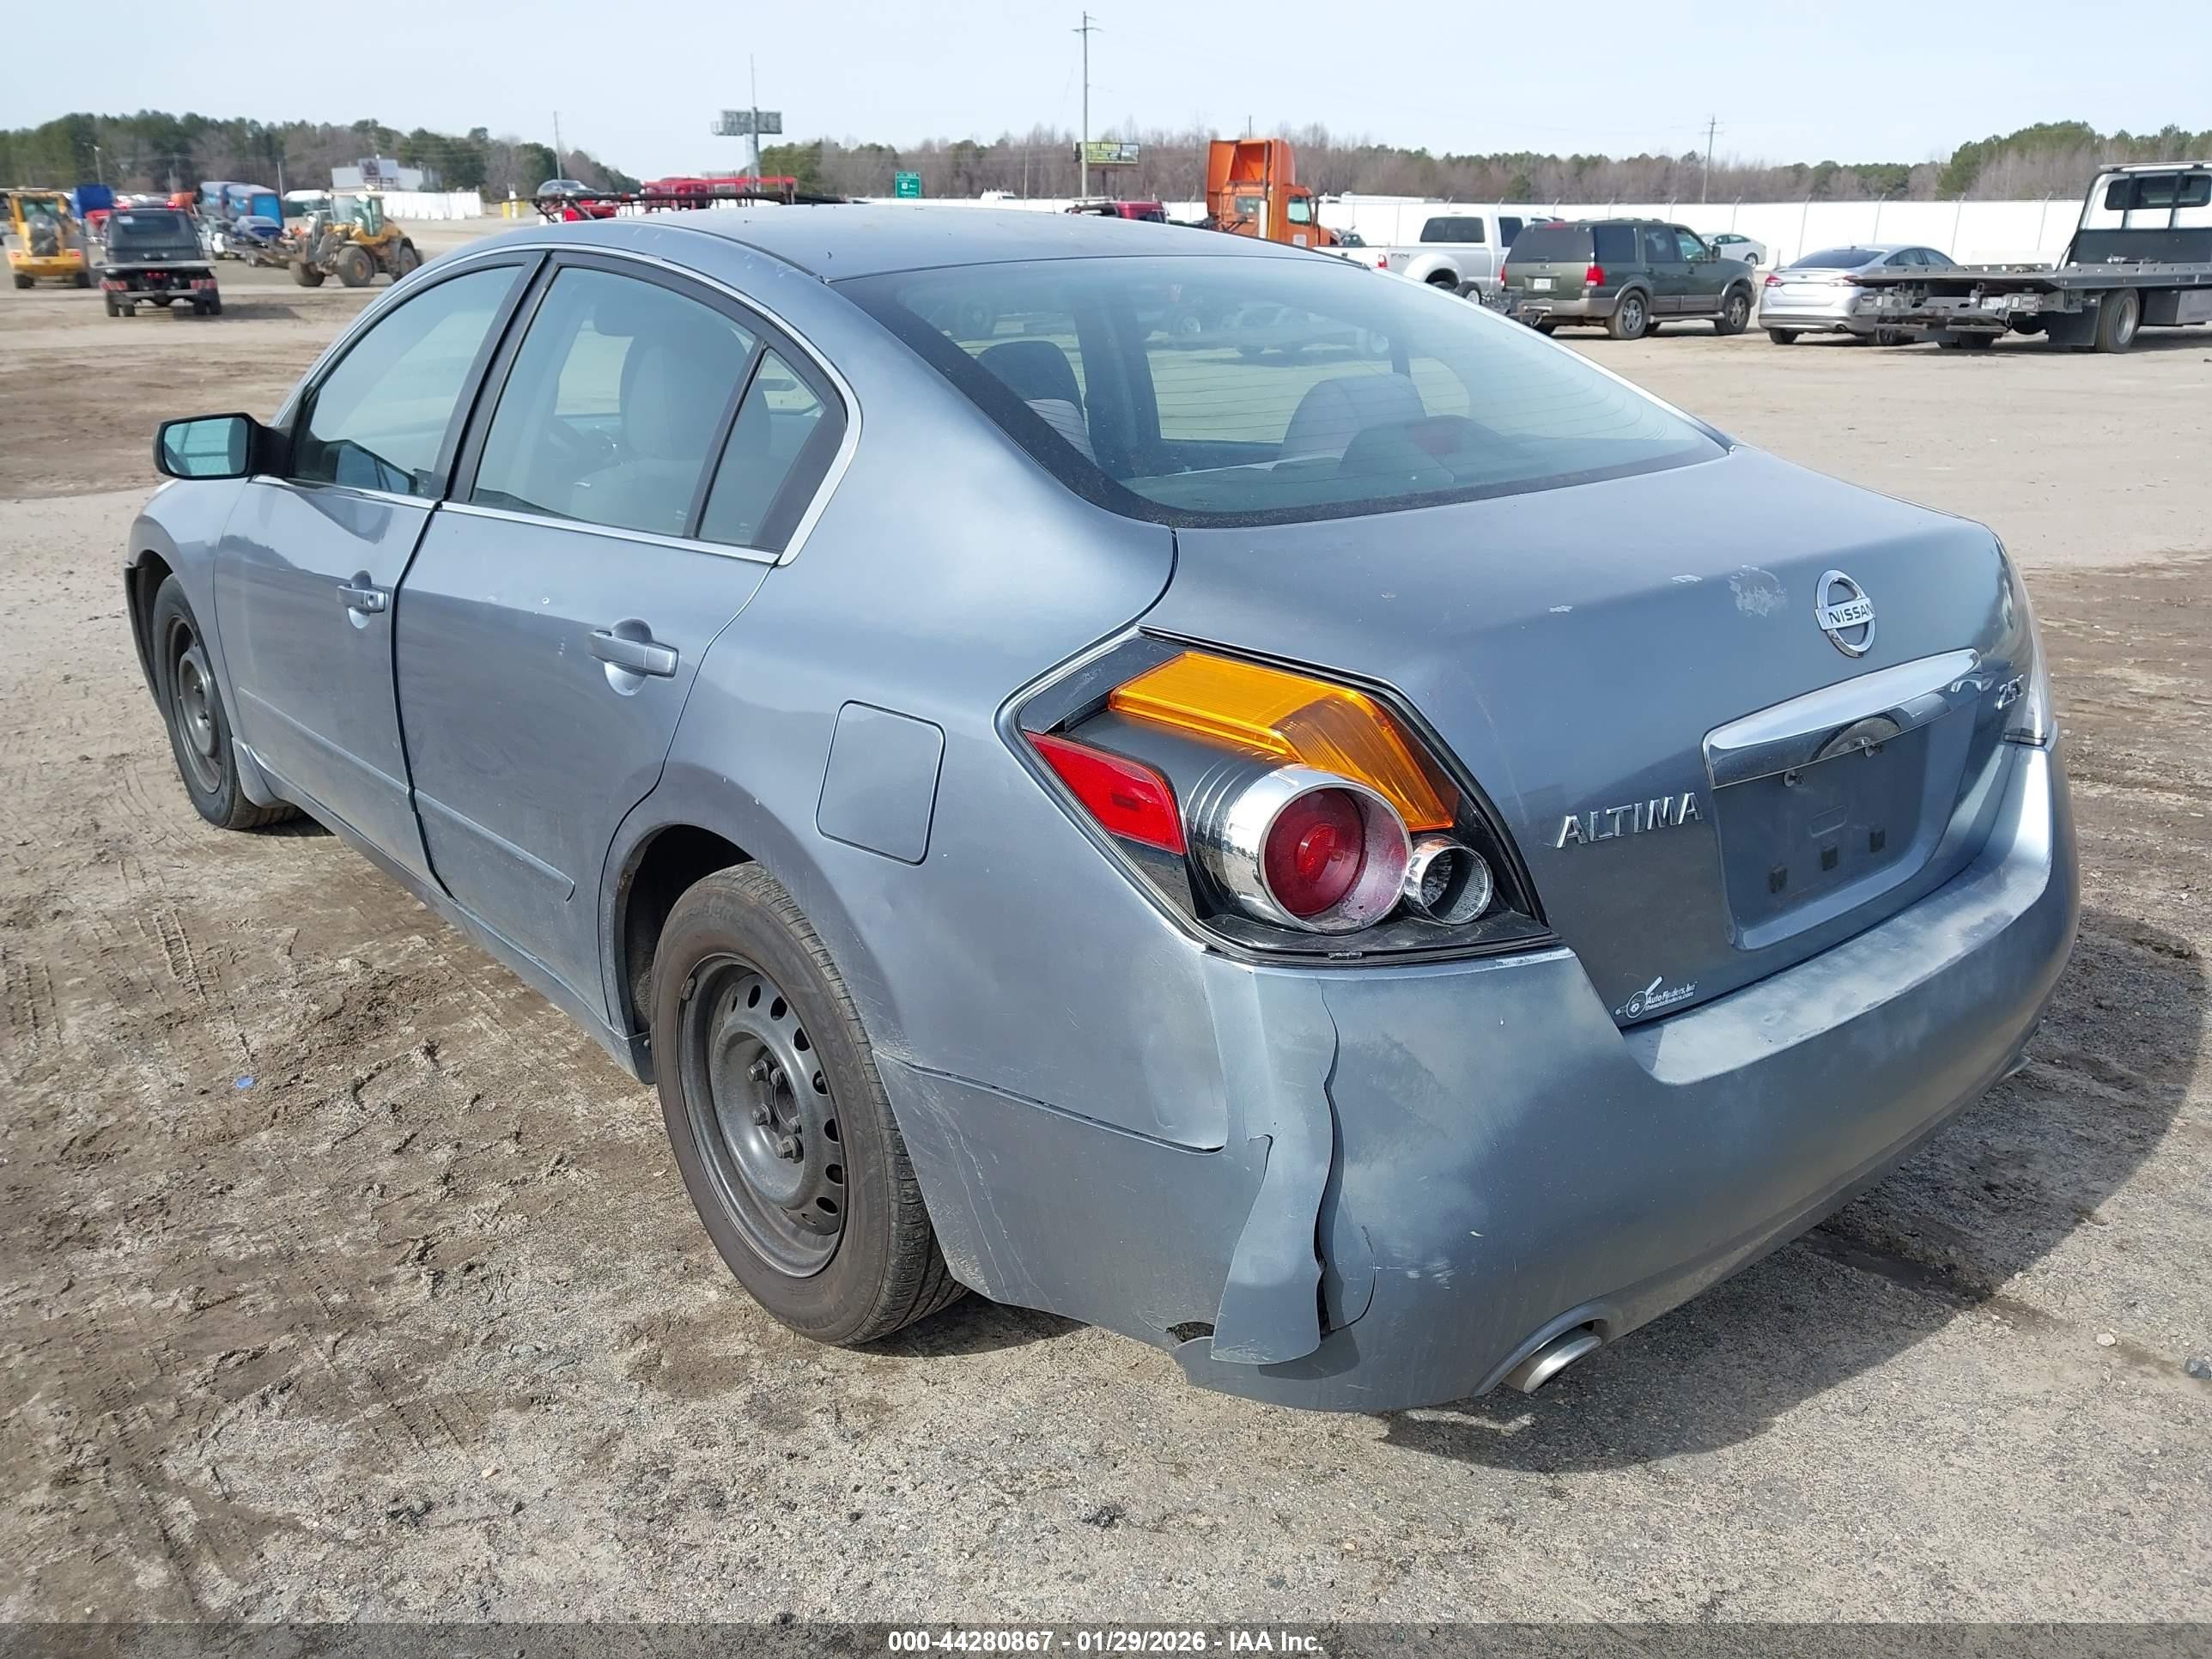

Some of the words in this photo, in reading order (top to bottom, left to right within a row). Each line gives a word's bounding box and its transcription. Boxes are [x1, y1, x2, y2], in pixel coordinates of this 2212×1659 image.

[1827, 603, 1875, 625] NISSAN
[1555, 792, 1704, 849] ALTIMA
[1647, 994, 1662, 1005] Auto
